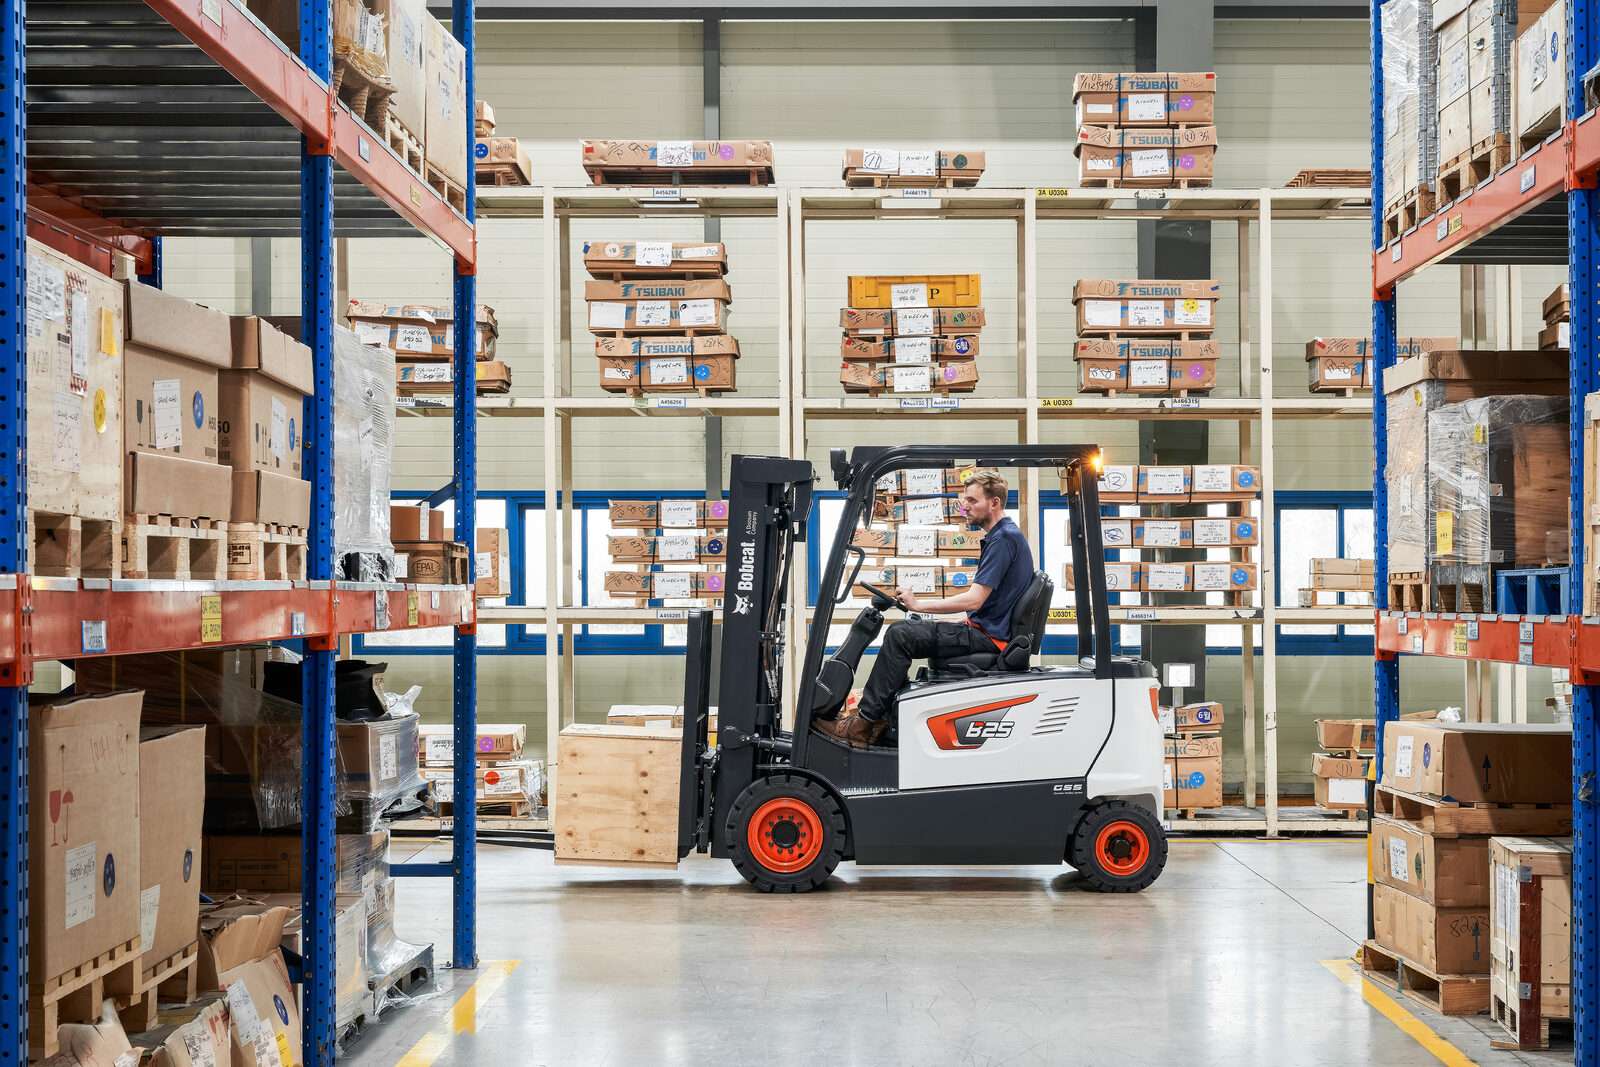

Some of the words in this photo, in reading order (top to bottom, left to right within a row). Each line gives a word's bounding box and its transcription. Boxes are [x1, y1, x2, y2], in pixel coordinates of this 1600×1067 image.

[1129, 80, 1178, 90] TSUBAKI
[1130, 135, 1180, 145] TSUBAKI
[635, 287, 685, 297] TSUBAKI
[929, 288, 940, 300] P
[1131, 287, 1181, 296] TSUBAKI
[1131, 347, 1181, 357] TSUBAKI
[750, 511, 758, 535] Company
[737, 541, 756, 591] Bobcat
[1052, 610, 1071, 618] U0301
